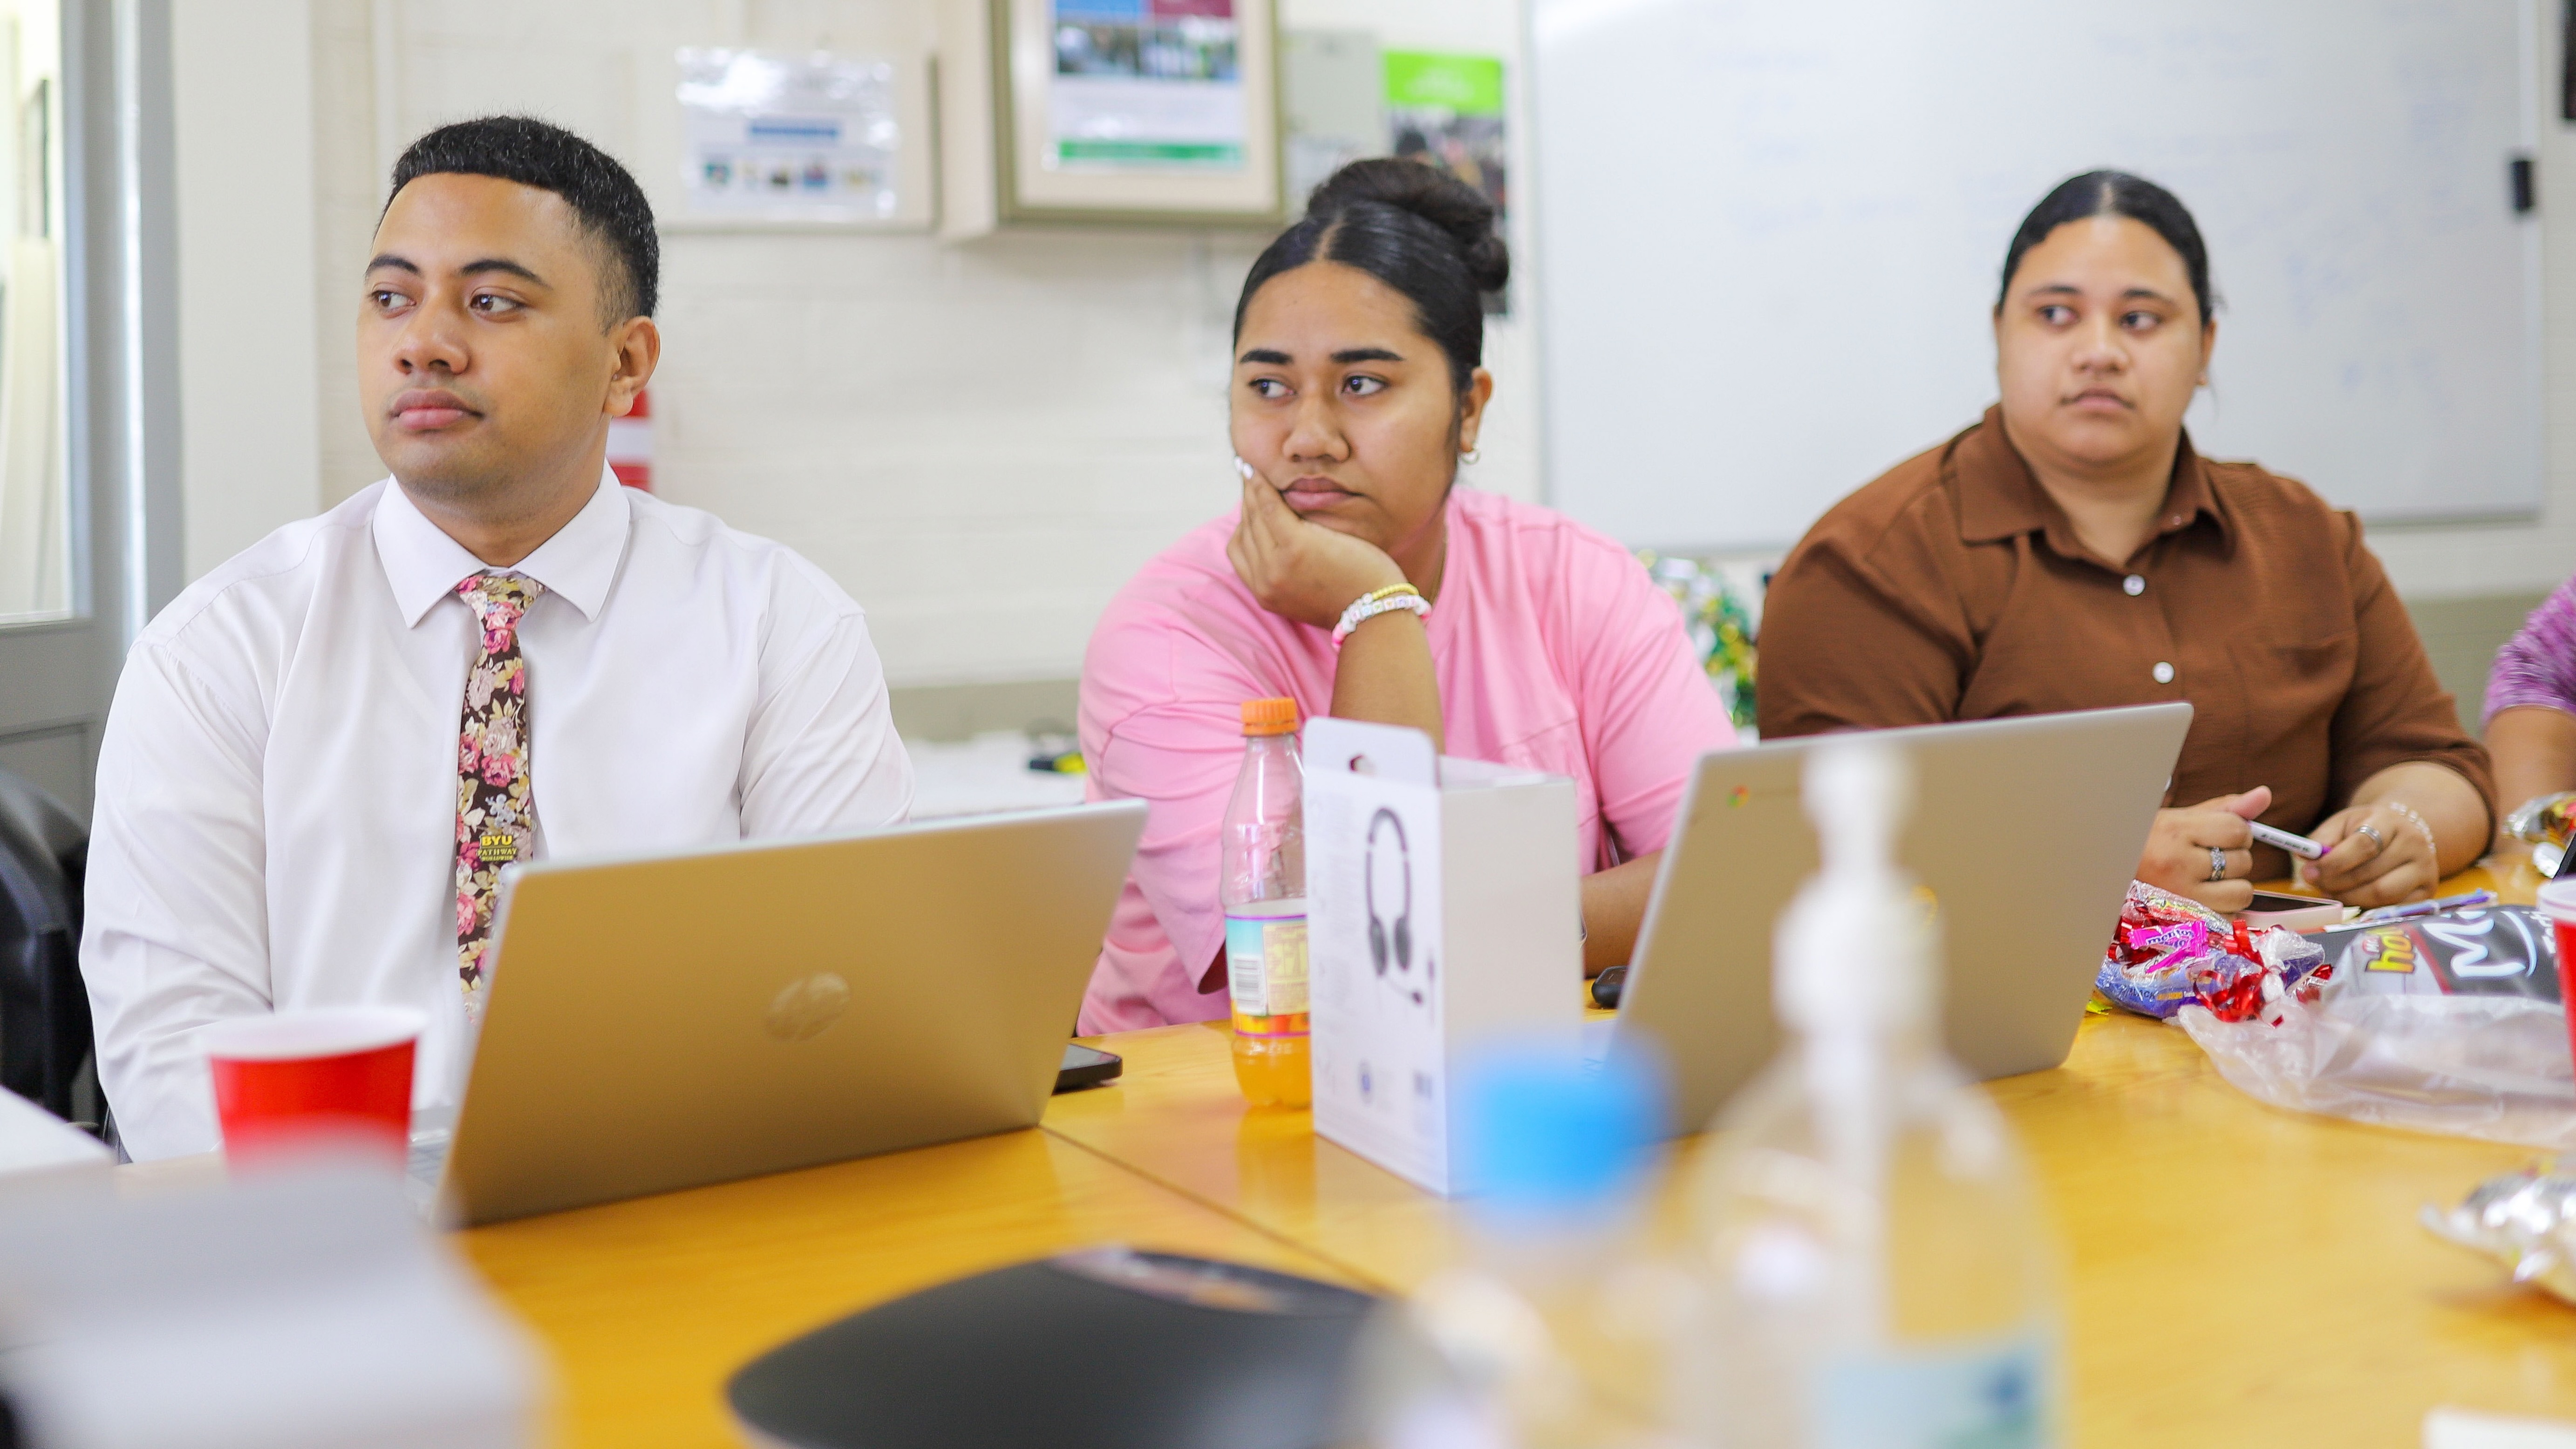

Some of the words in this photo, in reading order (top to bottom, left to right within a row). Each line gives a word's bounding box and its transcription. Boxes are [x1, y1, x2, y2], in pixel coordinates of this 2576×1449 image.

[482, 835, 513, 846] BYU
[477, 847, 517, 856] PATHWAY
[2147, 929, 2194, 944] mentos
